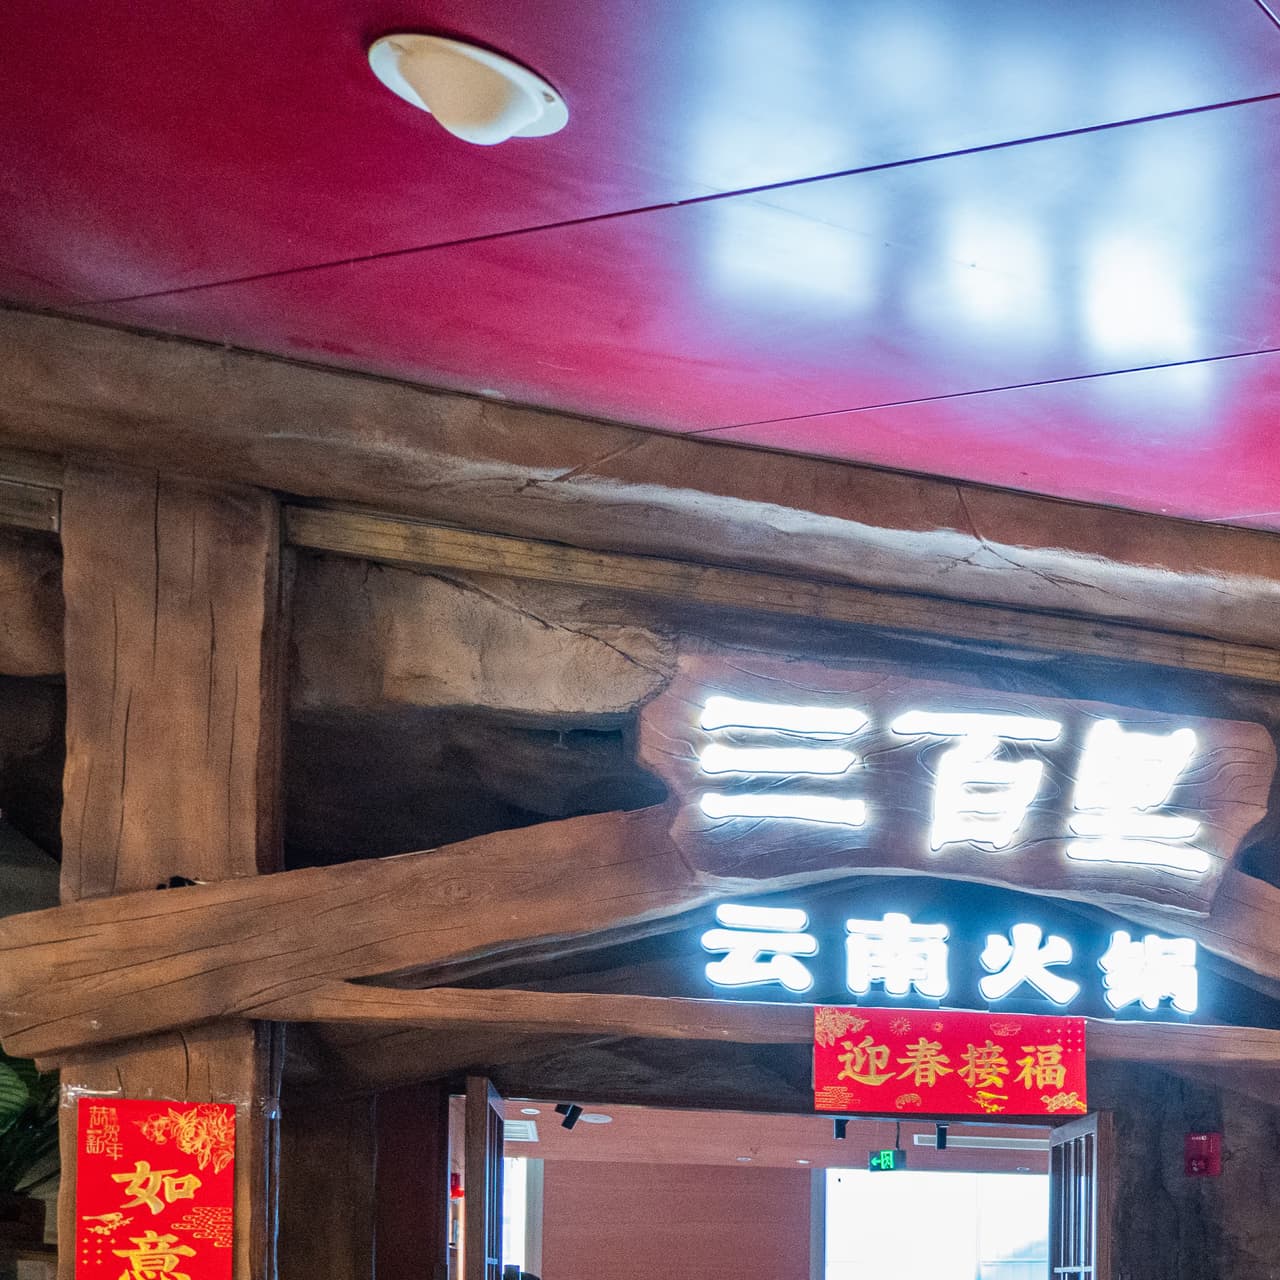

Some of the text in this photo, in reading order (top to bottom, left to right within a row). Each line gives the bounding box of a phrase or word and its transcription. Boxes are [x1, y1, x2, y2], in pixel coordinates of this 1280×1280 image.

[699, 694, 1212, 874] 三百里
[701, 903, 1199, 1015] 云南火锅
[836, 1037, 1067, 1091] 迎春接福
